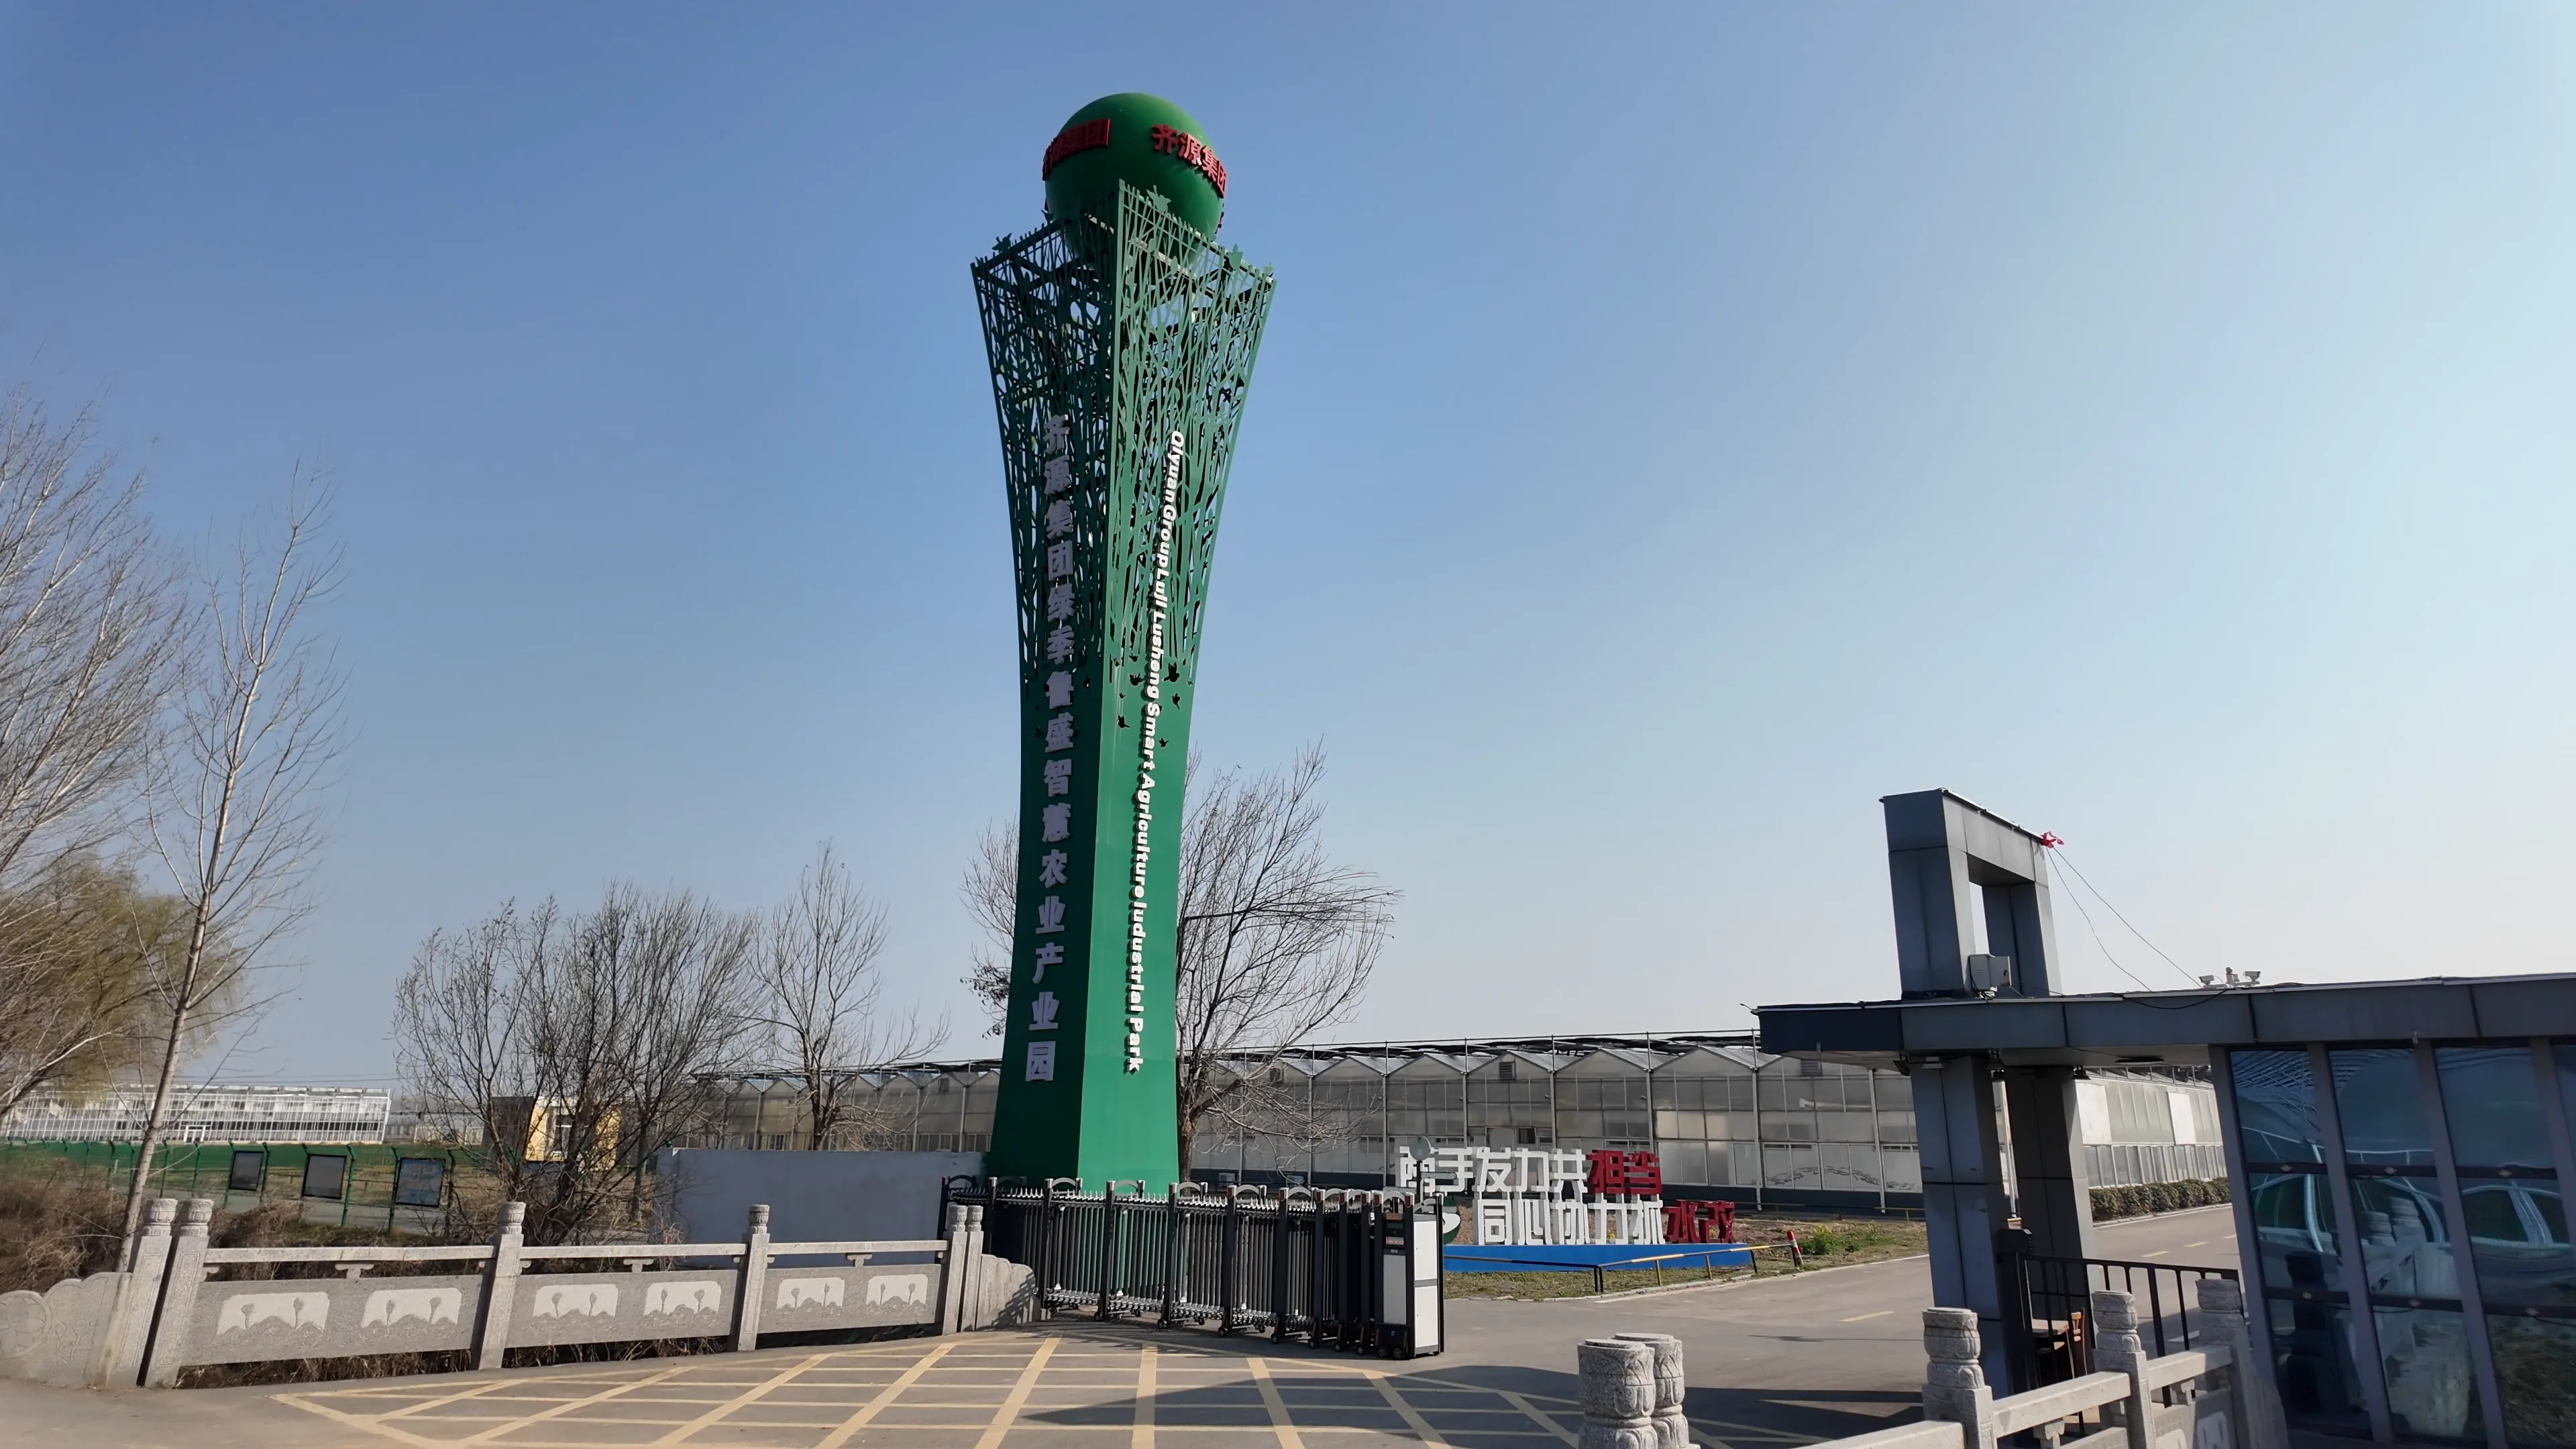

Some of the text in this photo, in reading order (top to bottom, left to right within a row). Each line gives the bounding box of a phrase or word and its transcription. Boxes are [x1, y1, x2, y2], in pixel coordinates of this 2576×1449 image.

[1042, 118, 1110, 181] 源集团
[1152, 123, 1228, 199] 齐源集团
[1157, 504, 1177, 568] Group
[1145, 610, 1167, 700] Lusheng
[1142, 702, 1161, 771] Smart
[1126, 1017, 1144, 1072] Park
